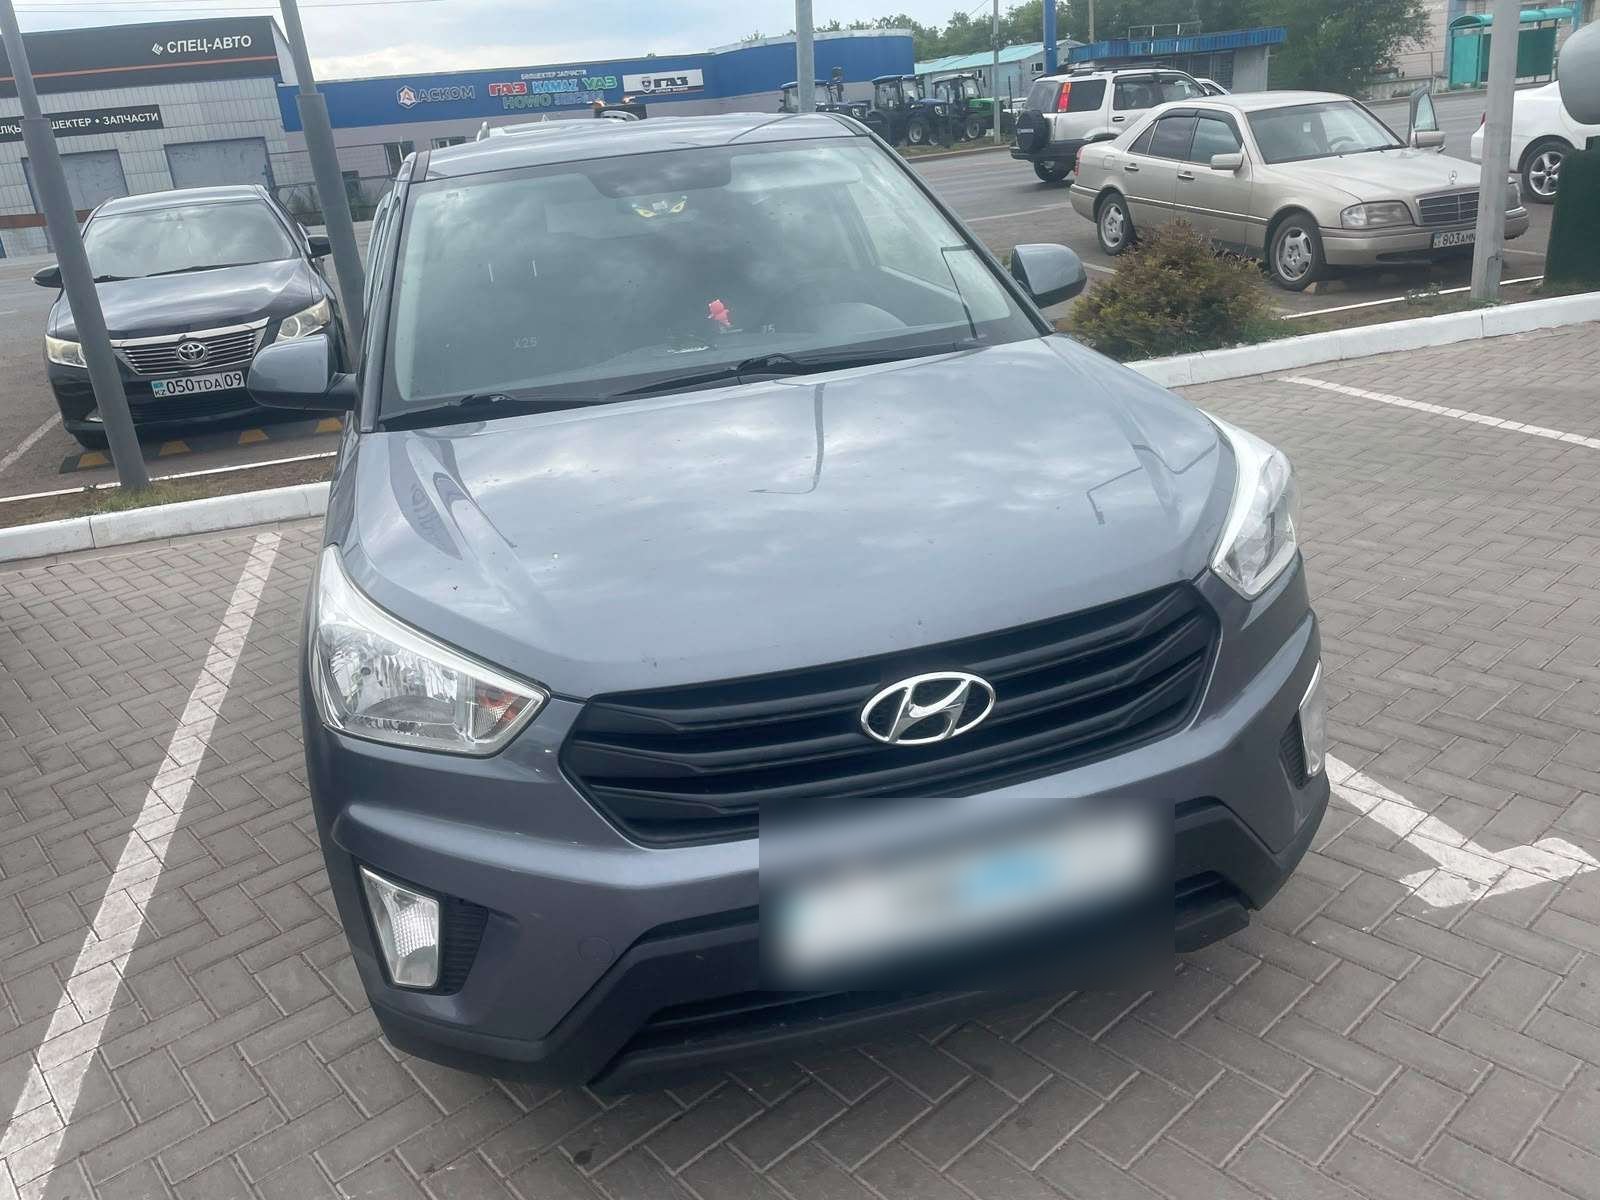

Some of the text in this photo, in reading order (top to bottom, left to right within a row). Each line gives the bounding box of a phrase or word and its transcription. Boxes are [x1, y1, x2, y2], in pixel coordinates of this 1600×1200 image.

[166, 35, 252, 53] СПЕЦ-АВТО
[488, 82, 528, 96] ГАЗ
[582, 76, 618, 90] УАЗ
[654, 77, 689, 88] ГАЗ
[417, 85, 476, 102] АСКОМ
[103, 113, 159, 126] ЗАПЧАСТИ
